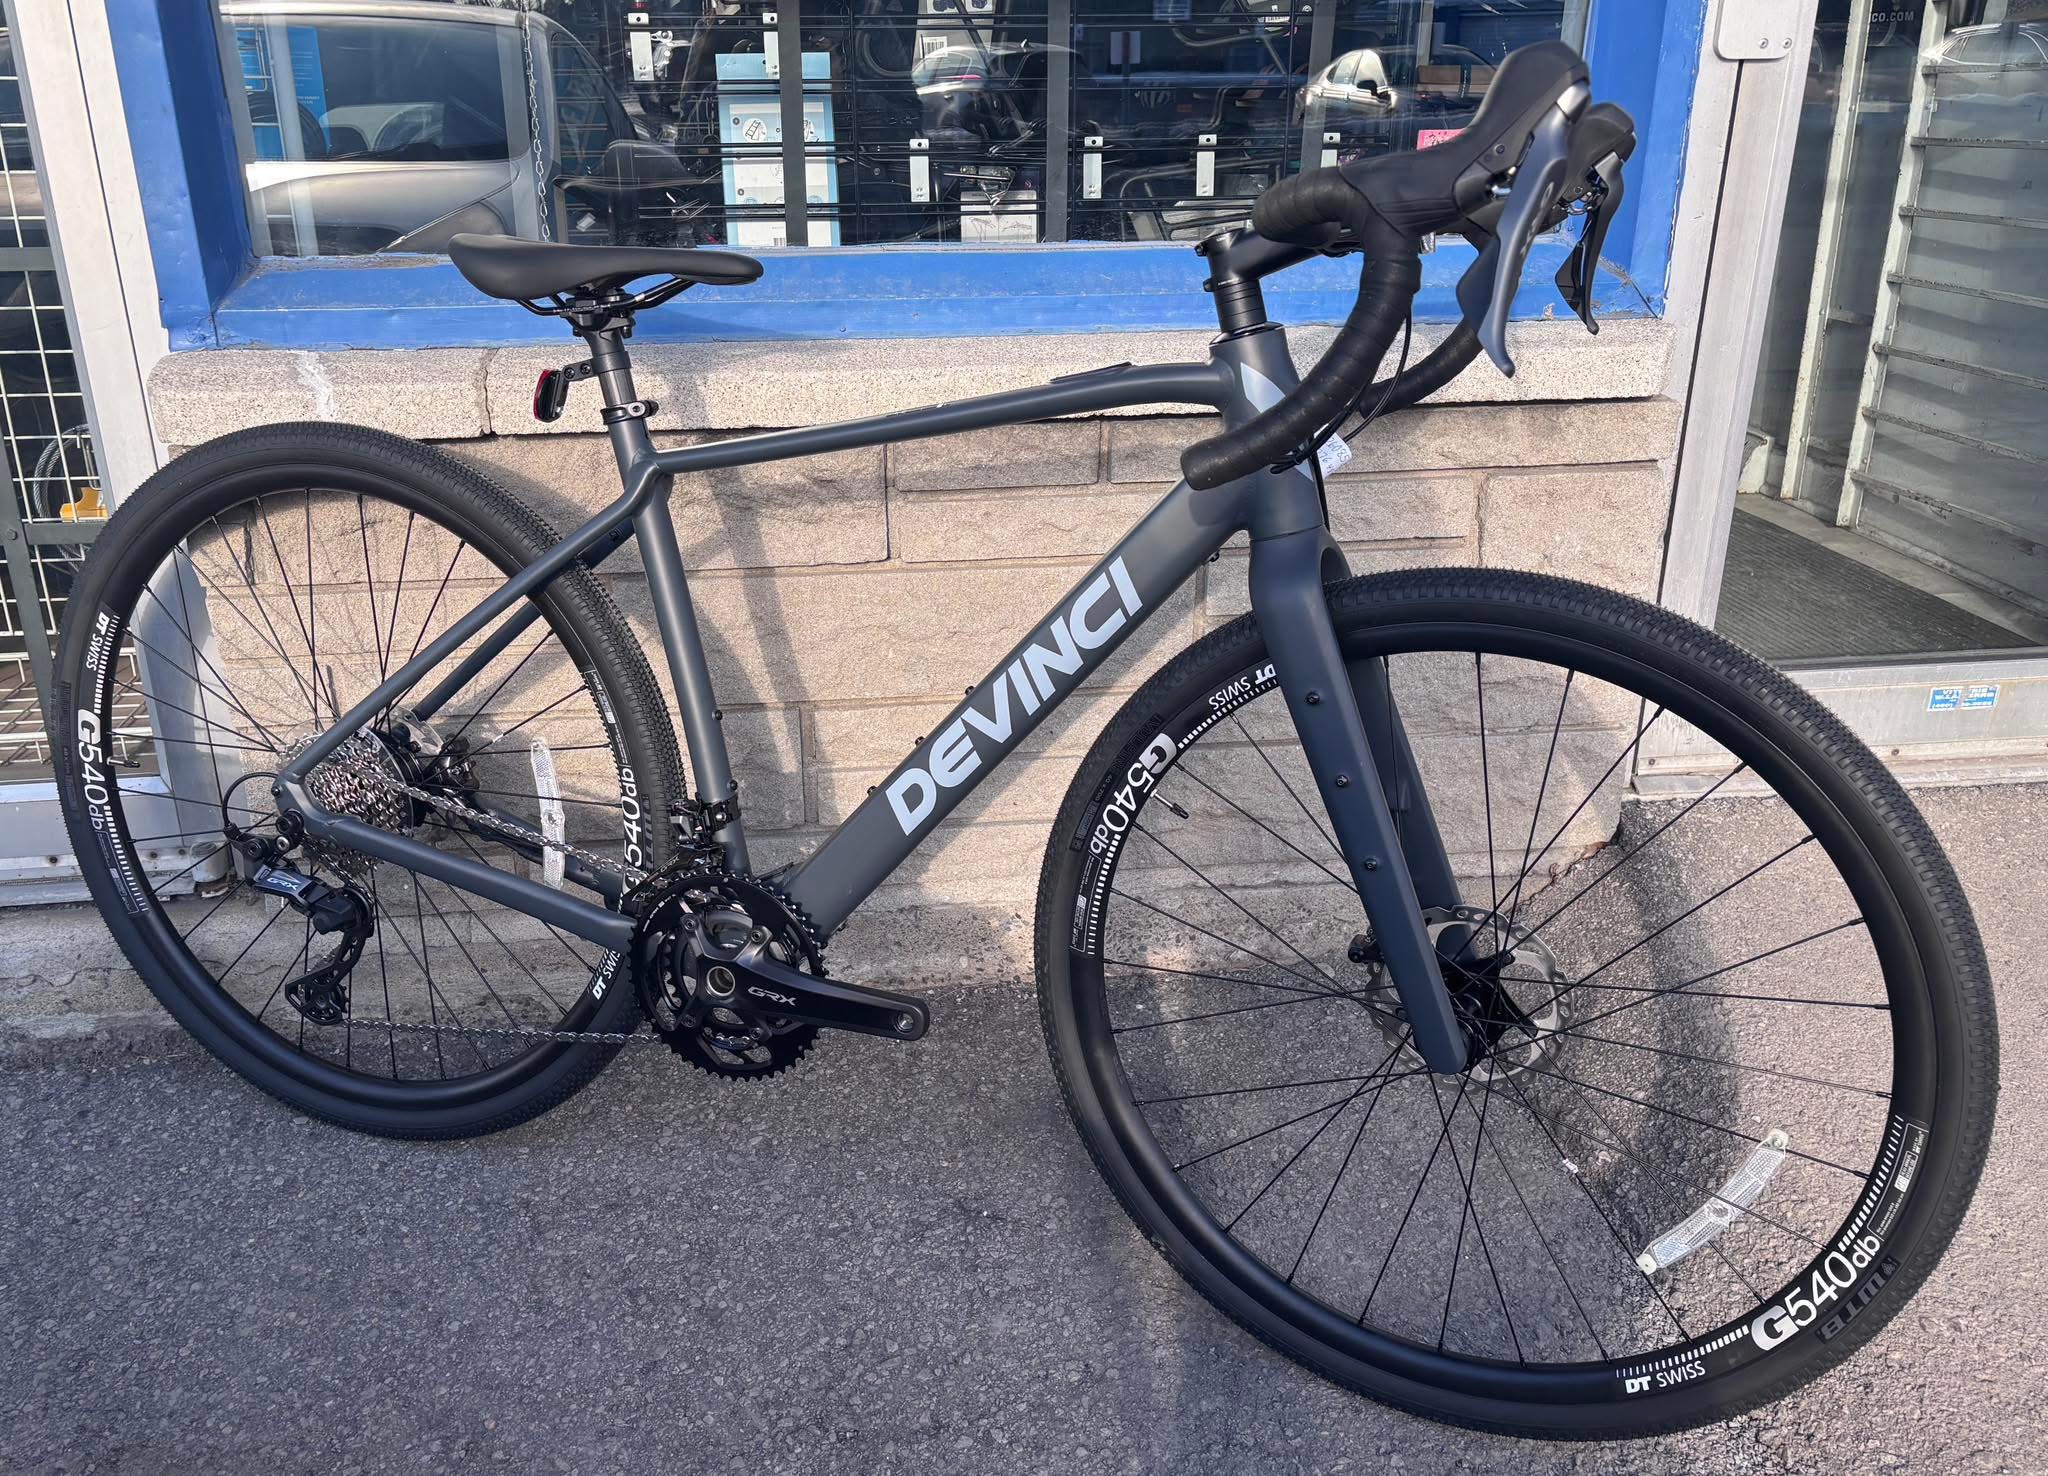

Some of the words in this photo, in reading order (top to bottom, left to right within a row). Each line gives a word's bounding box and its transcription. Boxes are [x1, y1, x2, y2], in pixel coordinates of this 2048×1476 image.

[95, 611, 111, 635] DT
[86, 632, 104, 671] SWISS
[1254, 664, 1277, 685] DT
[885, 555, 1143, 836] DEVINCI
[1208, 676, 1251, 710] SWISS
[267, 877, 299, 891] GRX
[592, 975, 607, 1000] DT
[747, 986, 797, 1006] GRX
[1625, 1376, 1652, 1394] DT
[1656, 1360, 1707, 1388] SWISS
